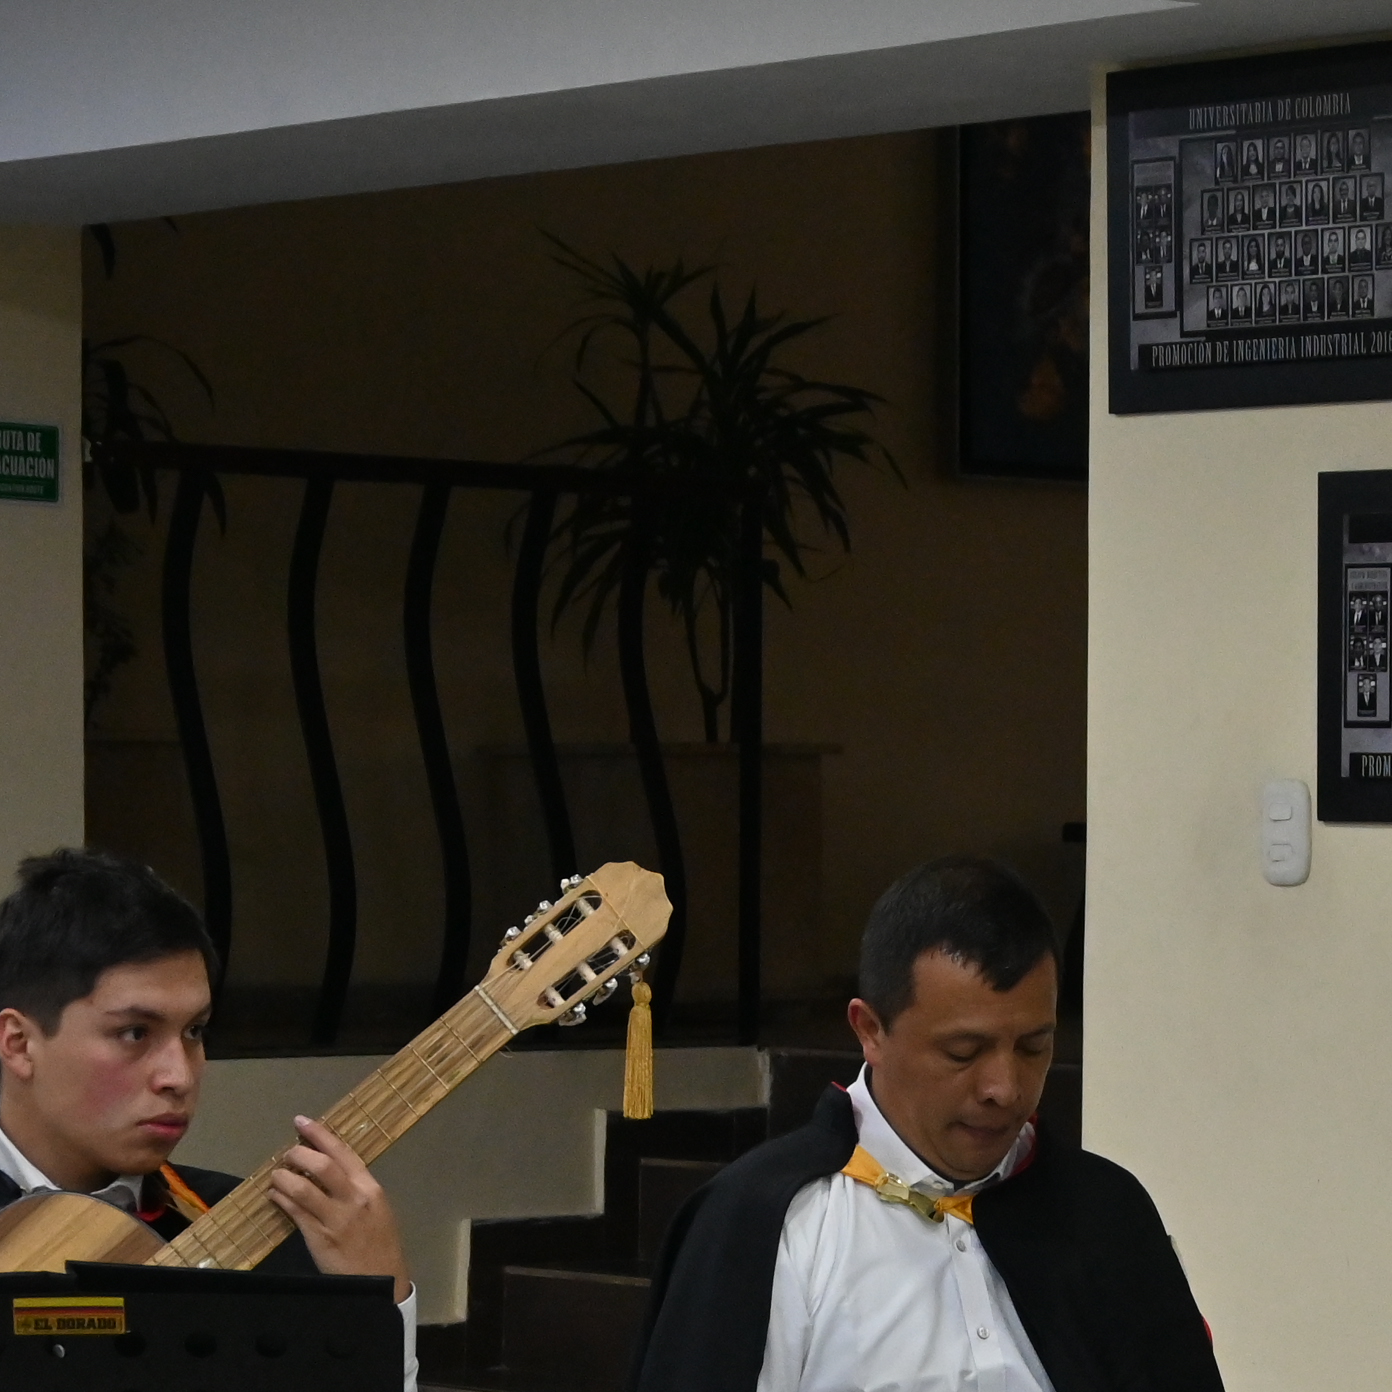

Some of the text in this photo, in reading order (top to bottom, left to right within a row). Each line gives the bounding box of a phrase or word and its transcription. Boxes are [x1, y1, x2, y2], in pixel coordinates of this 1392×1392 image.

[1188, 92, 1351, 130] UNIVERSITARIA DE COLOMBIA
[1152, 339, 1212, 367] PROMOCIÓN
[1216, 341, 1230, 363] DE
[1233, 337, 1297, 362] INGENIERIA
[1300, 333, 1367, 358] INDUSTRIAL
[26, 431, 42, 453] DE
[33, 1317, 117, 1331] EL DORADO
